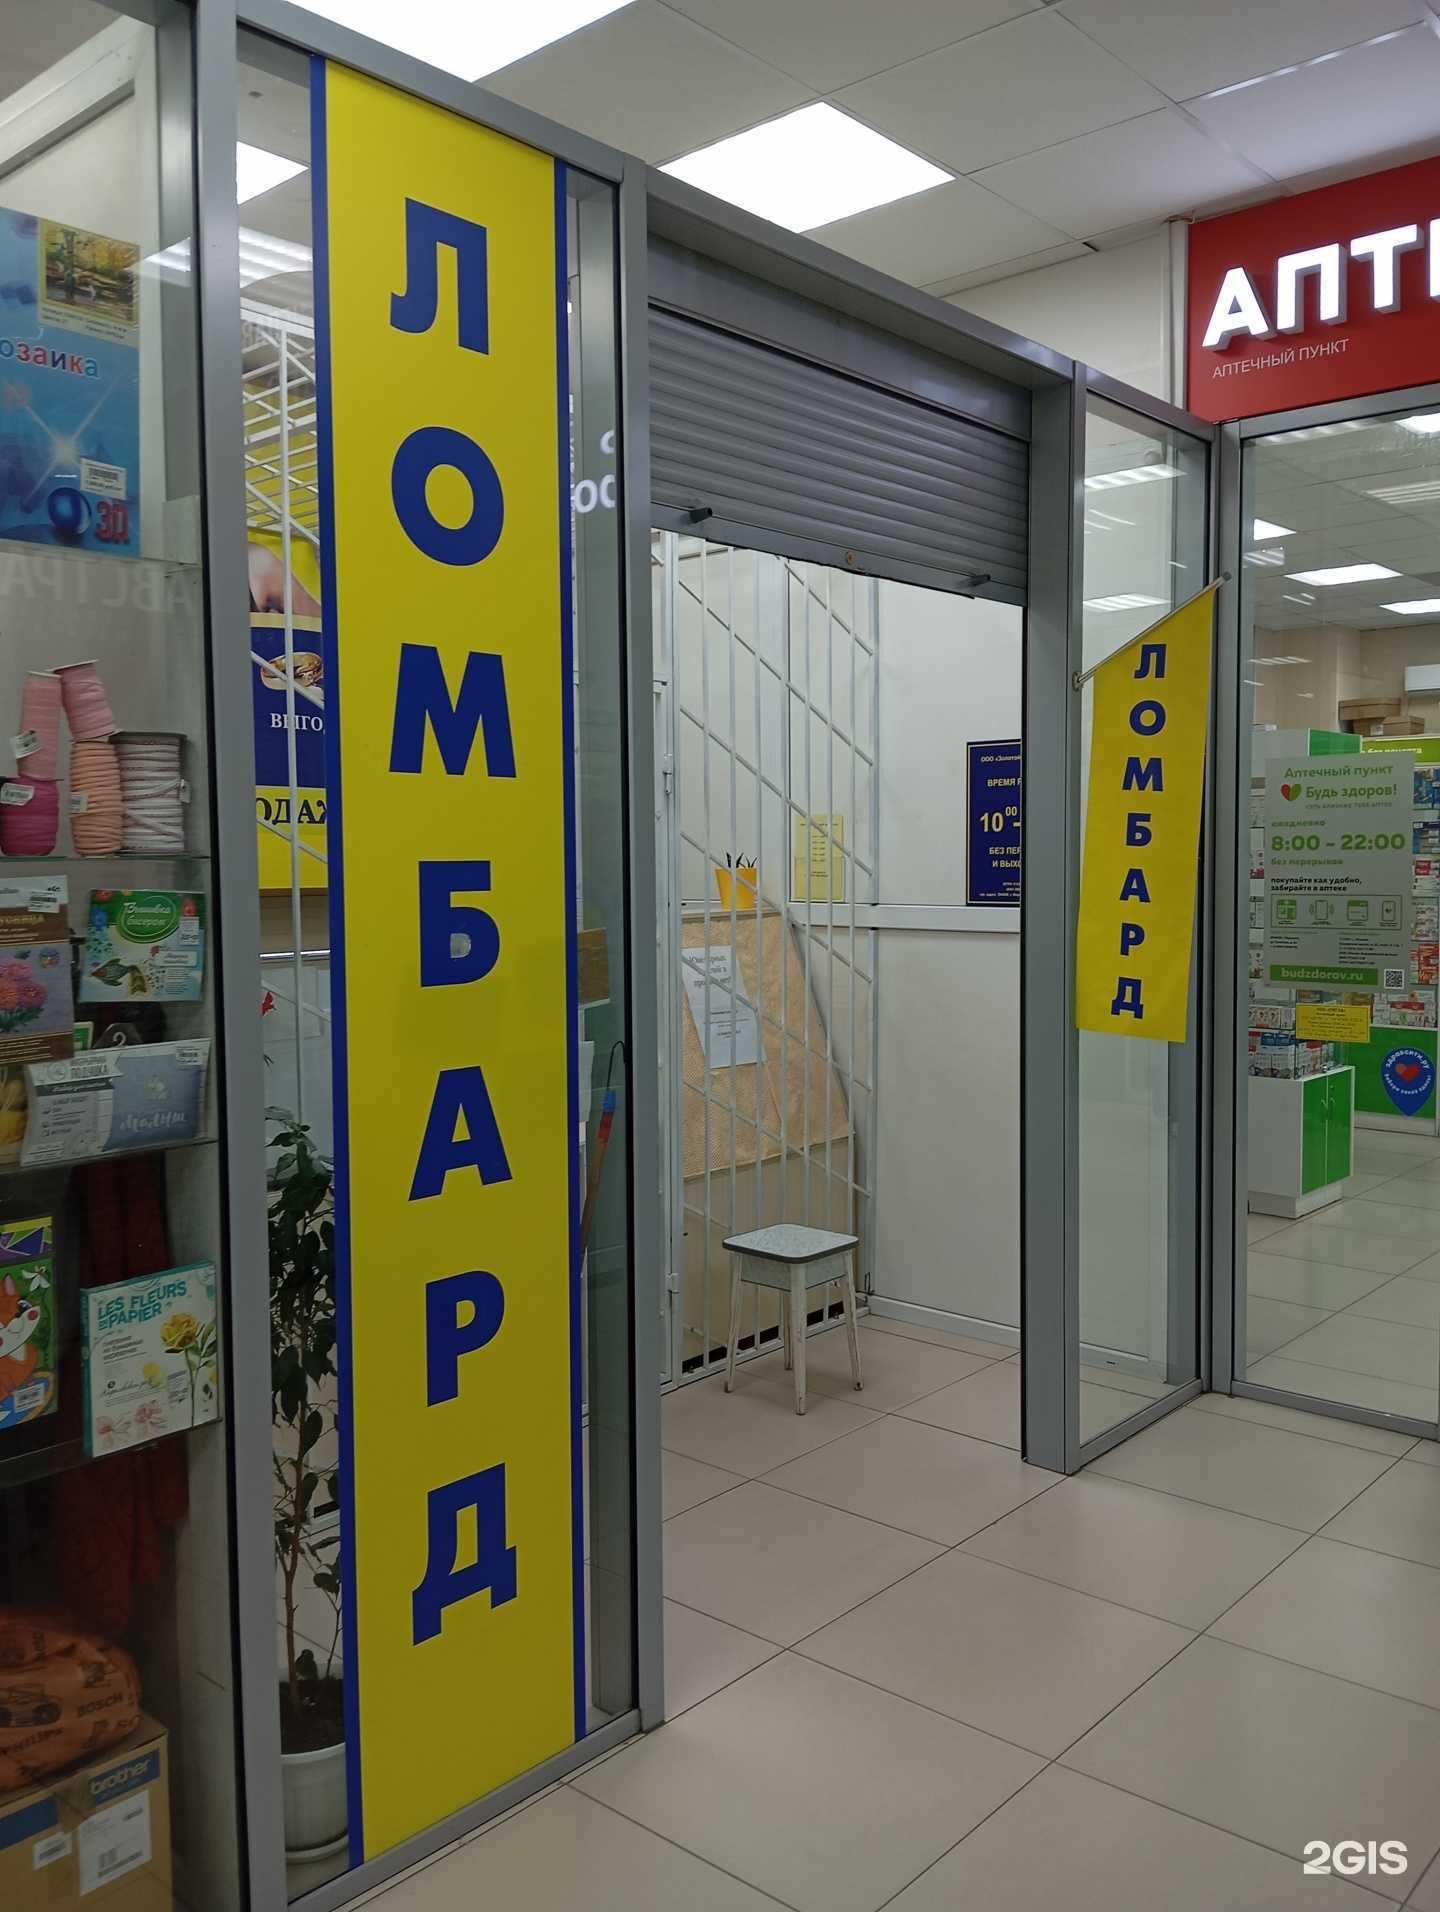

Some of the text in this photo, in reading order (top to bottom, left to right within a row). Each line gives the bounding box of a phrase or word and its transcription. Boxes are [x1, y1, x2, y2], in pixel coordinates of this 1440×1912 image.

[1212, 338, 1350, 378] АПТЕЧНЫЙ ПУНКТ
[1284, 765, 1393, 779] Аптечный пункт
[987, 778, 1016, 787] ВРЕМЯ
[1306, 784, 1397, 799] Будь здоров!
[1110, 643, 1168, 1020] ЛОМБАРД
[1271, 835, 1320, 851] 8:00
[1341, 834, 1406, 851] 22:00
[989, 847, 1005, 855] БЕЗ
[992, 860, 998, 868] И
[1270, 857, 1287, 866] без
[1271, 876, 1312, 885] покупайте
[1329, 877, 1362, 885] удобно,
[1271, 884, 1312, 893] забирайте
[389, 197, 518, 1646] ЛОМБАРД
[1280, 967, 1364, 981] budzdorov.ru
[98, 1280, 187, 1320] LES FLEURS
[108, 1303, 162, 1328] PAPIER
[90, 1759, 151, 1795] brother
